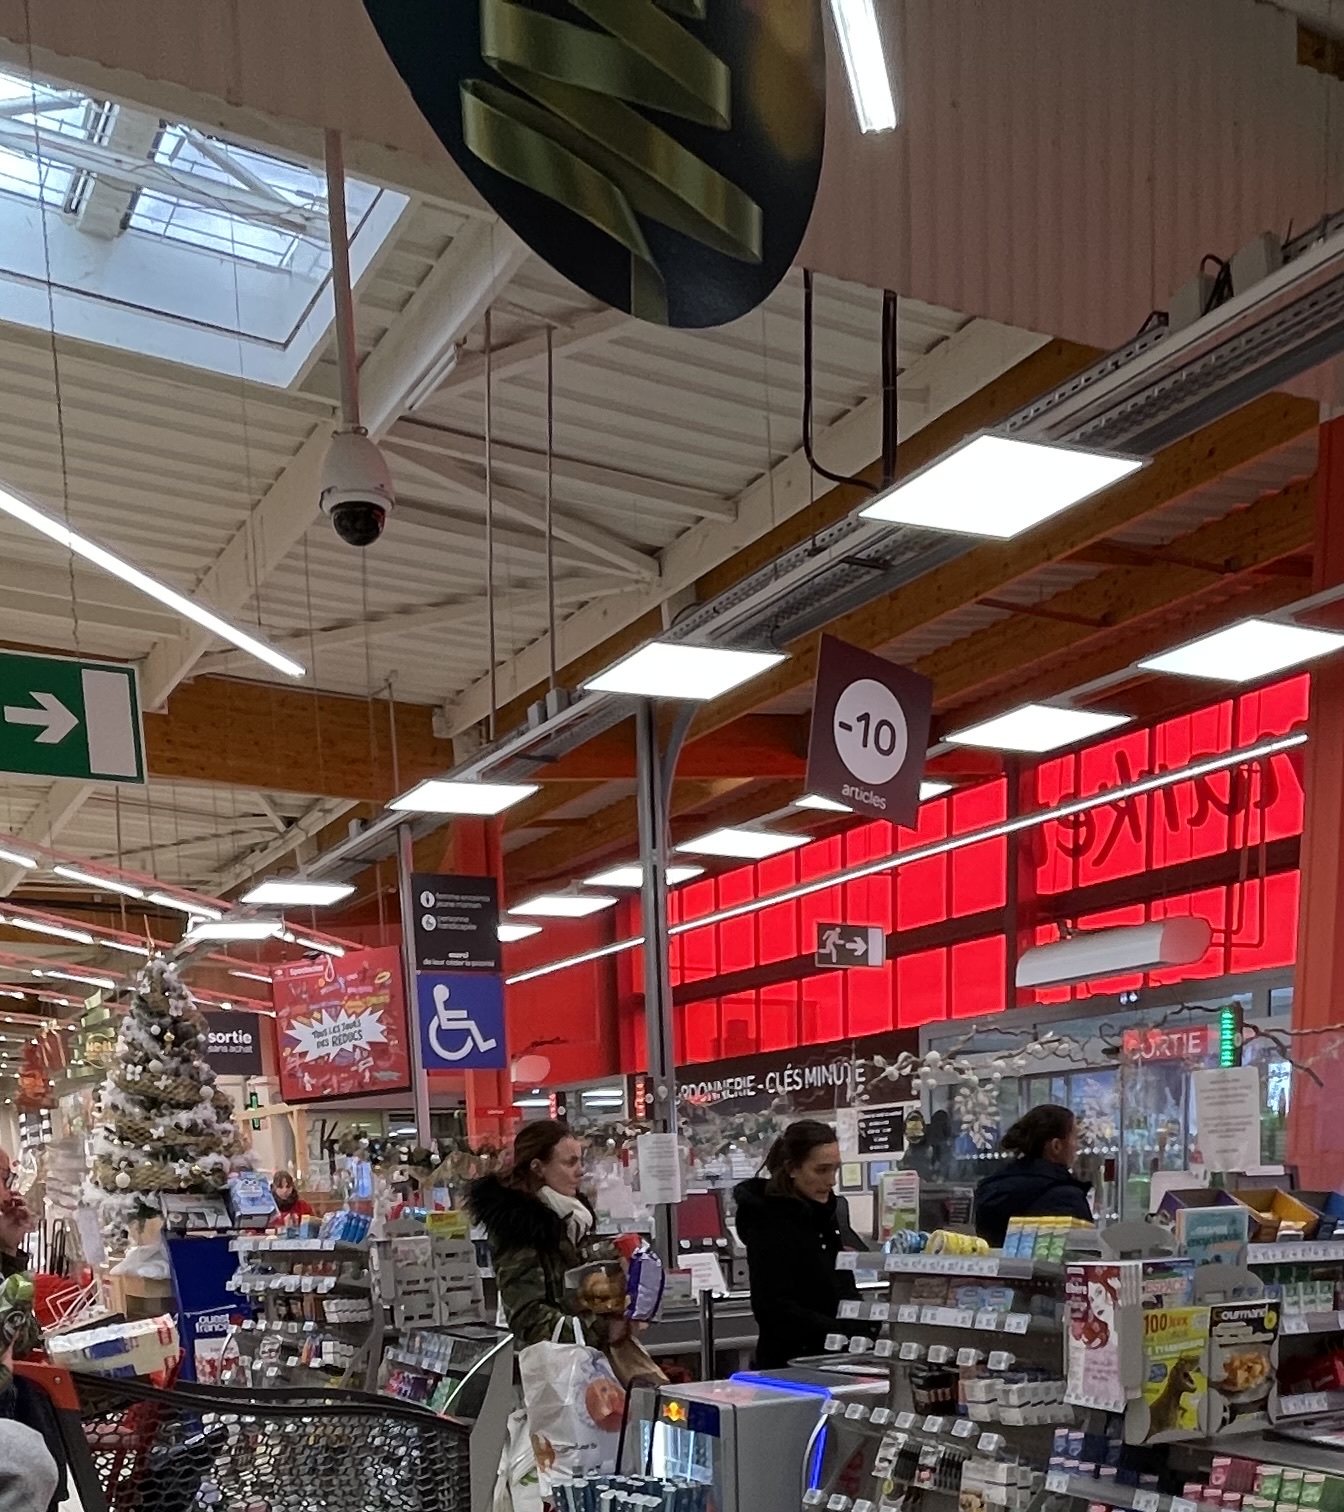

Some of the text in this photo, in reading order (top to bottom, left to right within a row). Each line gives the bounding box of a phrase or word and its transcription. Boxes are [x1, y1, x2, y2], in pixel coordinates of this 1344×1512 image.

[838, 711, 897, 757] -10
[841, 783, 887, 811] articles
[208, 1029, 253, 1045] sortie
